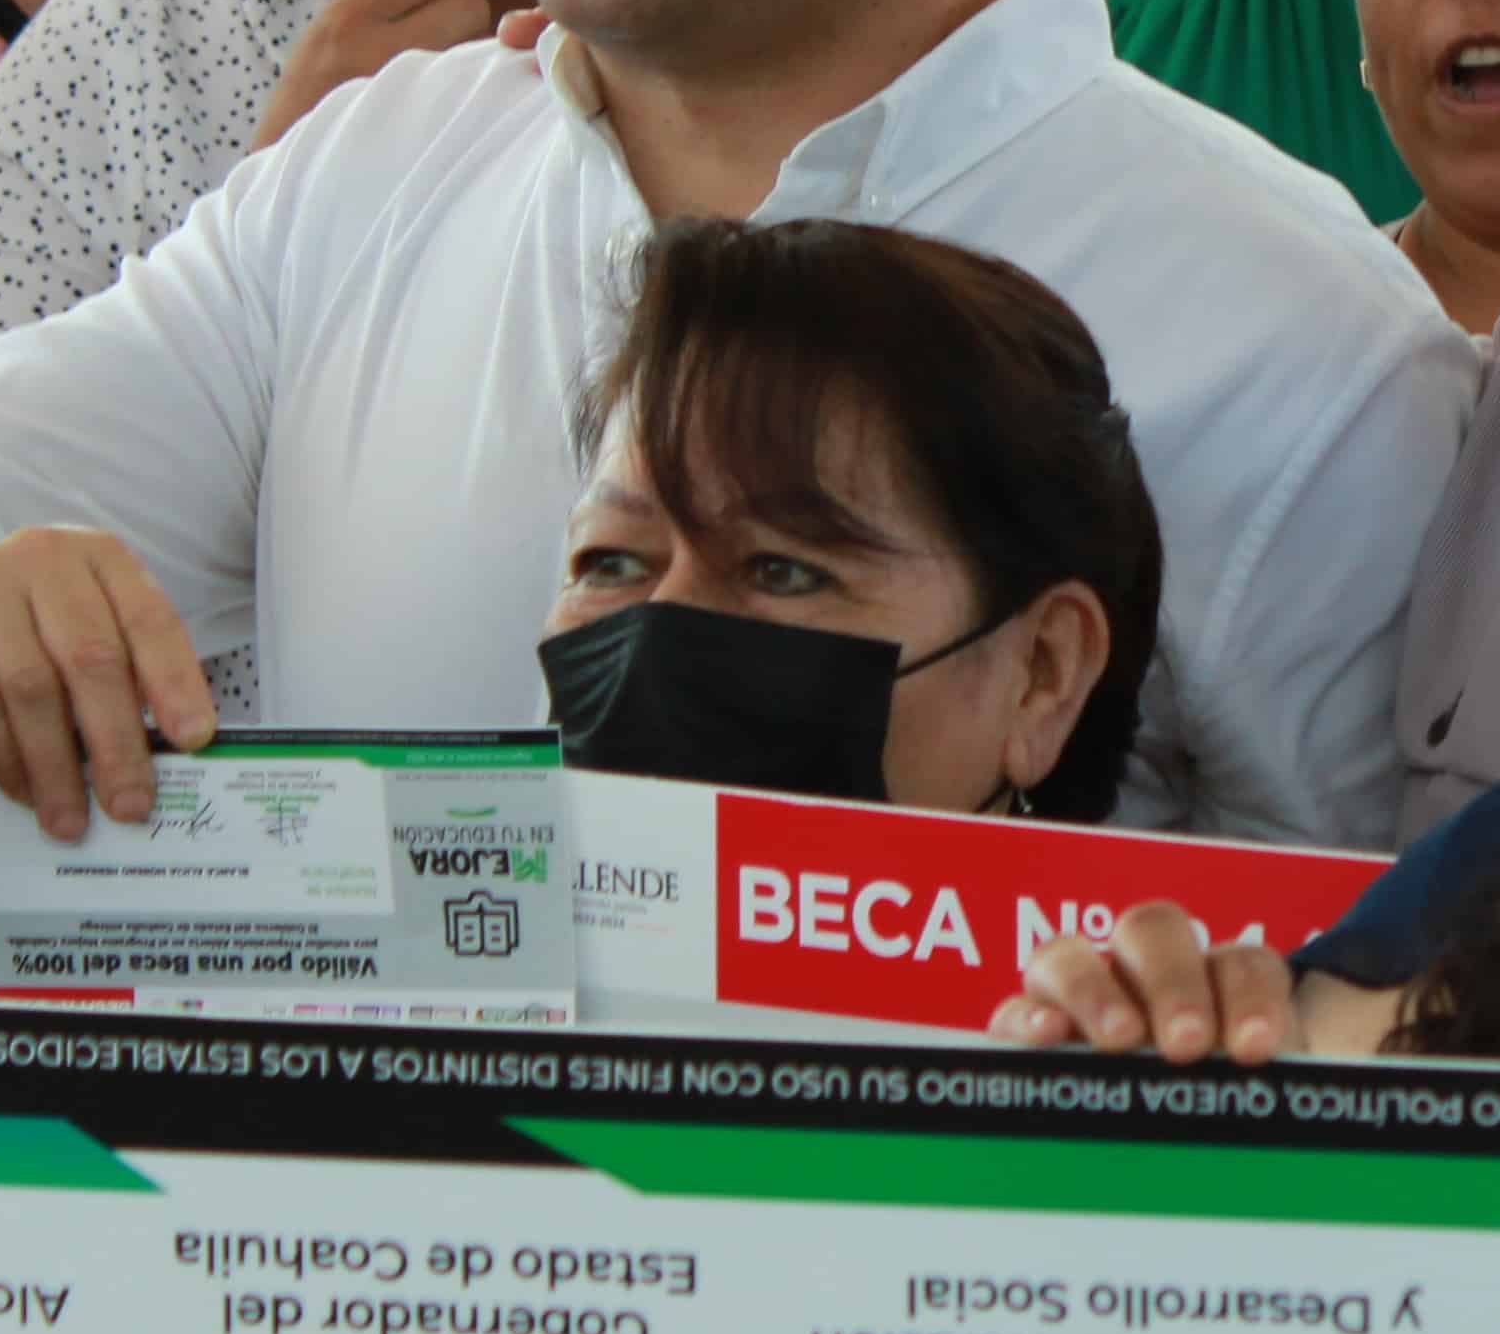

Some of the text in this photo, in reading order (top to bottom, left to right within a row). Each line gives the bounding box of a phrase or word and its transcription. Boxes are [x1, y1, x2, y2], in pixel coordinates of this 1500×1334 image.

[739, 865, 981, 966] BECA
[13, 951, 377, 979] Válido por una Beca del 100%
[260, 1043, 330, 1078] LOS
[338, 1048, 365, 1079] A
[372, 1048, 559, 1088] DISTINTOS
[567, 1056, 673, 1093] FINES
[682, 1061, 765, 1097] CON
[771, 1064, 850, 1100] USO
[860, 1068, 909, 1103] SU
[916, 1070, 1131, 1112] PROHIBIDO
[1139, 1078, 1277, 1118] QUEDA
[1283, 1083, 1464, 1127] POLÍTICO,
[174, 1232, 697, 1296] Estado de Coahuila
[907, 1276, 1069, 1324] Social
[1392, 1286, 1422, 1328] y
